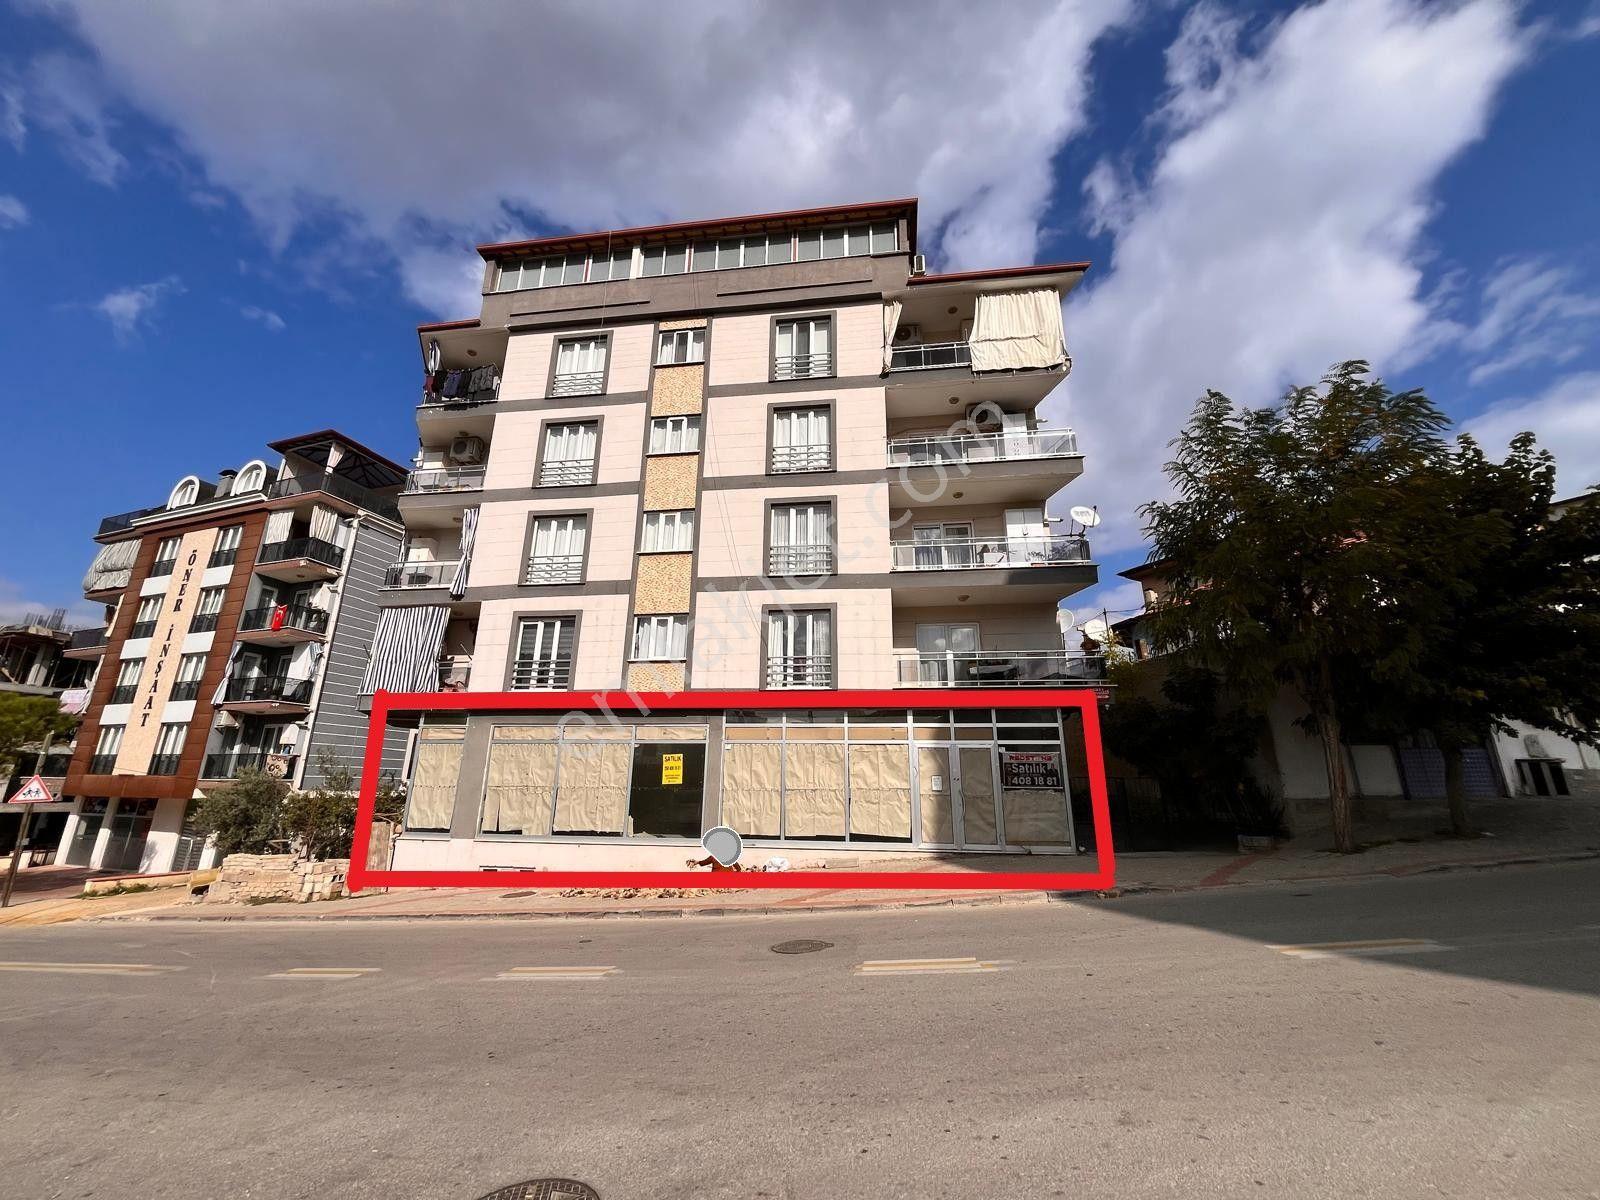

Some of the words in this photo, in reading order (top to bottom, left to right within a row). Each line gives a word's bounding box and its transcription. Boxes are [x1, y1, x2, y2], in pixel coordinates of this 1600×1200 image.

[173, 548, 197, 613] ÖNER
[141, 623, 174, 728] İNŞAAT
[1012, 763, 1046, 773] Satılık
[1012, 777, 1032, 785] 408
[1033, 776, 1045, 785] 18
[1046, 776, 1057, 786] 81
